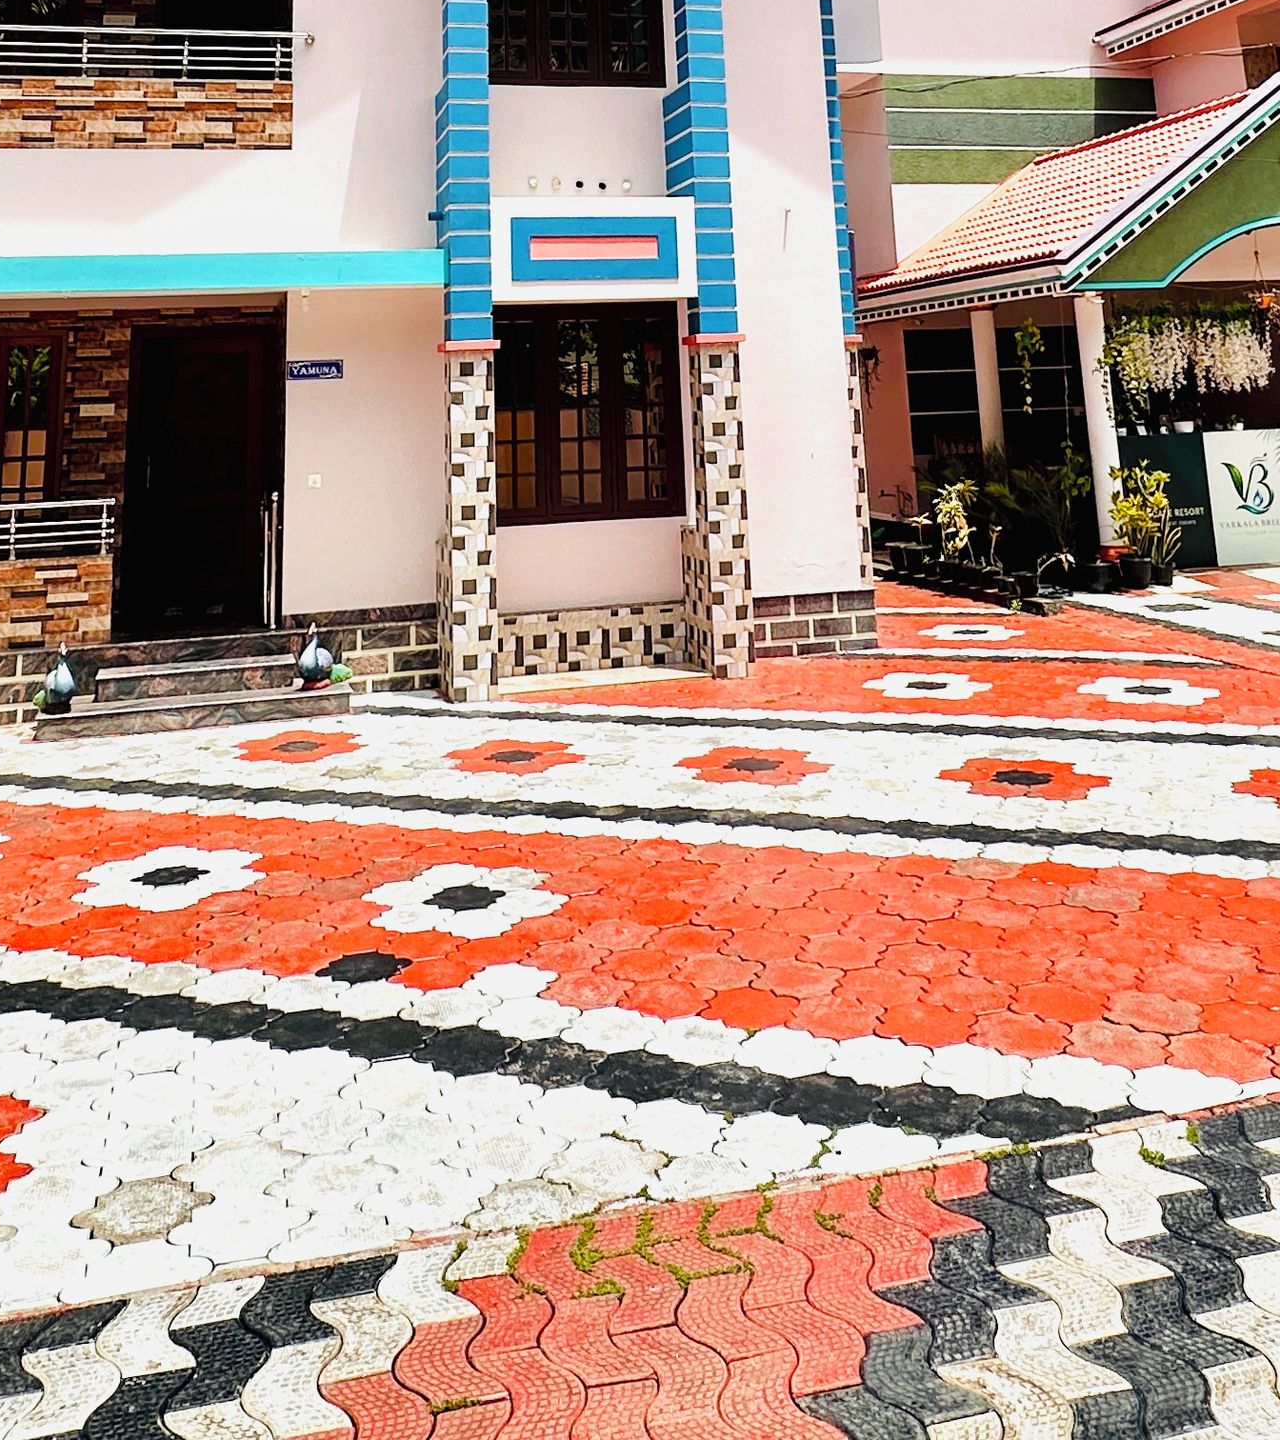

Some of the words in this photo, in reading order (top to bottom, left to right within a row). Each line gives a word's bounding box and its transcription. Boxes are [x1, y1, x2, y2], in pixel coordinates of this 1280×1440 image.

[292, 366, 338, 375] YAMUNA
[1174, 506, 1205, 516] RESORT
[1219, 519, 1259, 529] VARKALA
